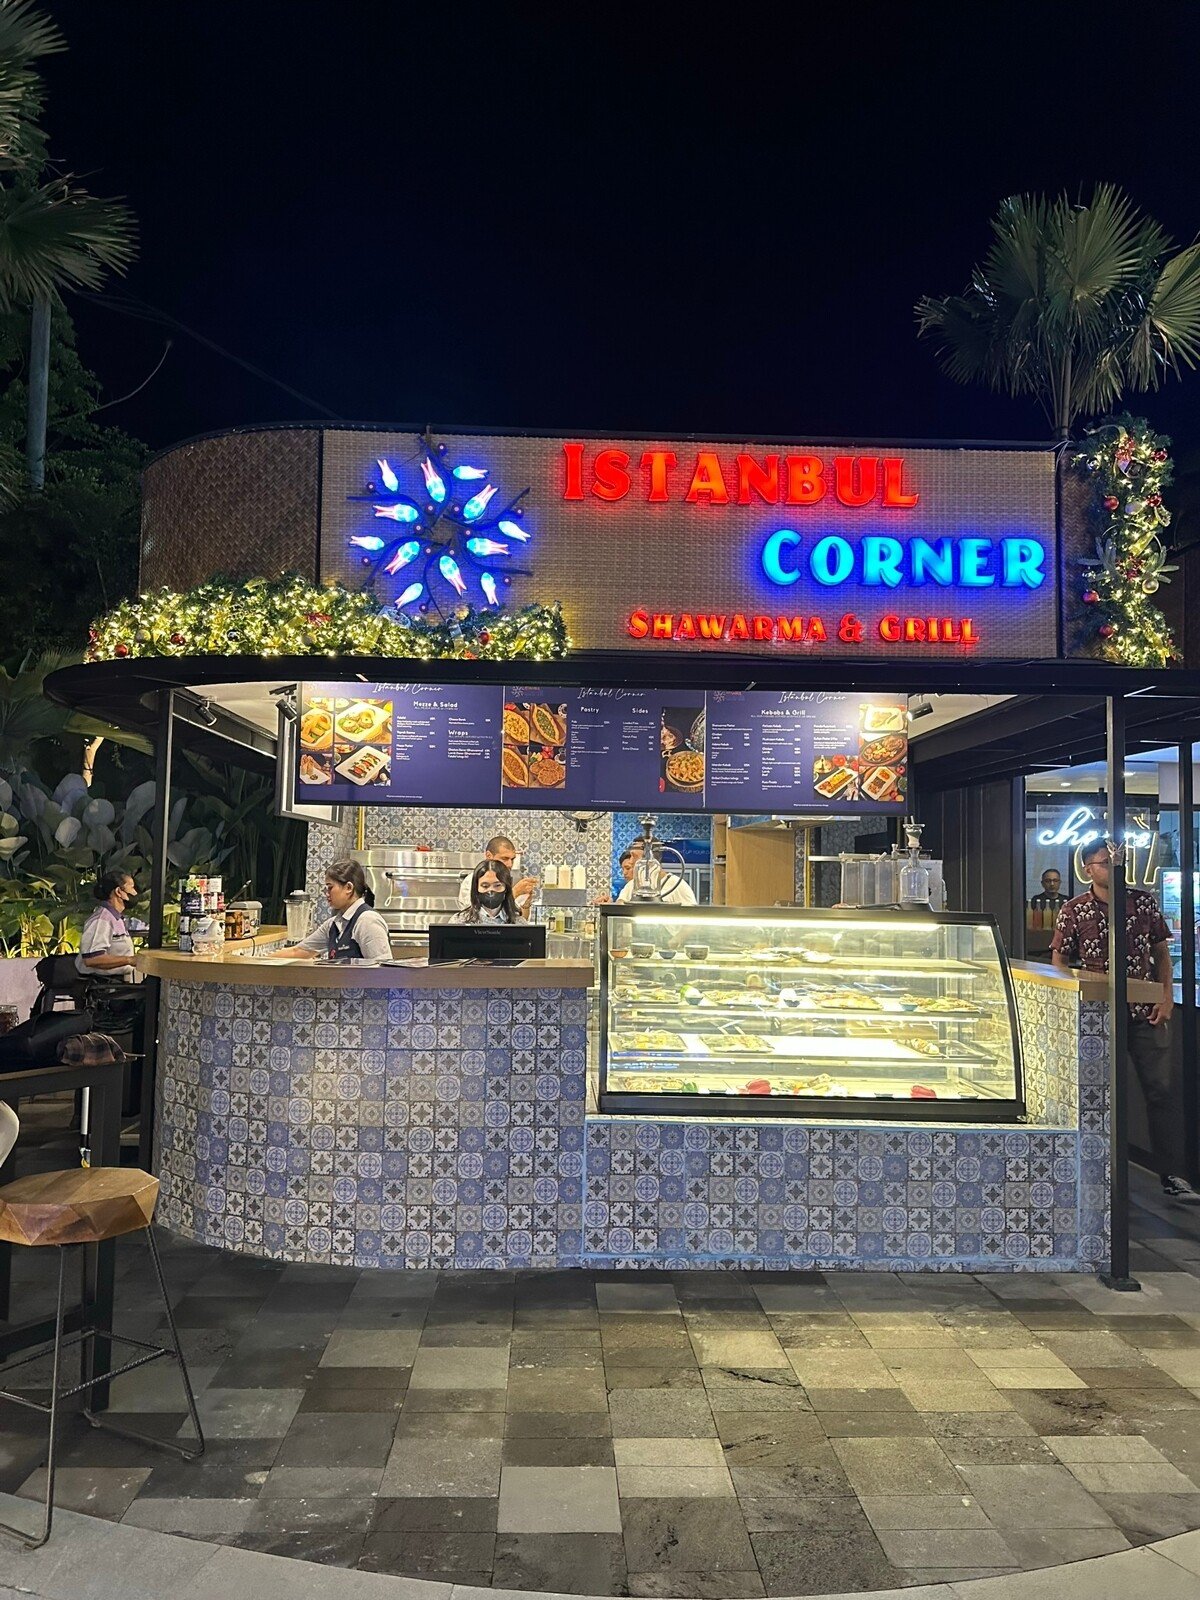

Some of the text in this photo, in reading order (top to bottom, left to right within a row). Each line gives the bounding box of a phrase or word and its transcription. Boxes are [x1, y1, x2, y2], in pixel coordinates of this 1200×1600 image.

[562, 442, 920, 509] ISTANBUL
[761, 528, 1046, 590] CORNER
[628, 609, 980, 644] SHAWARMA & GRILL
